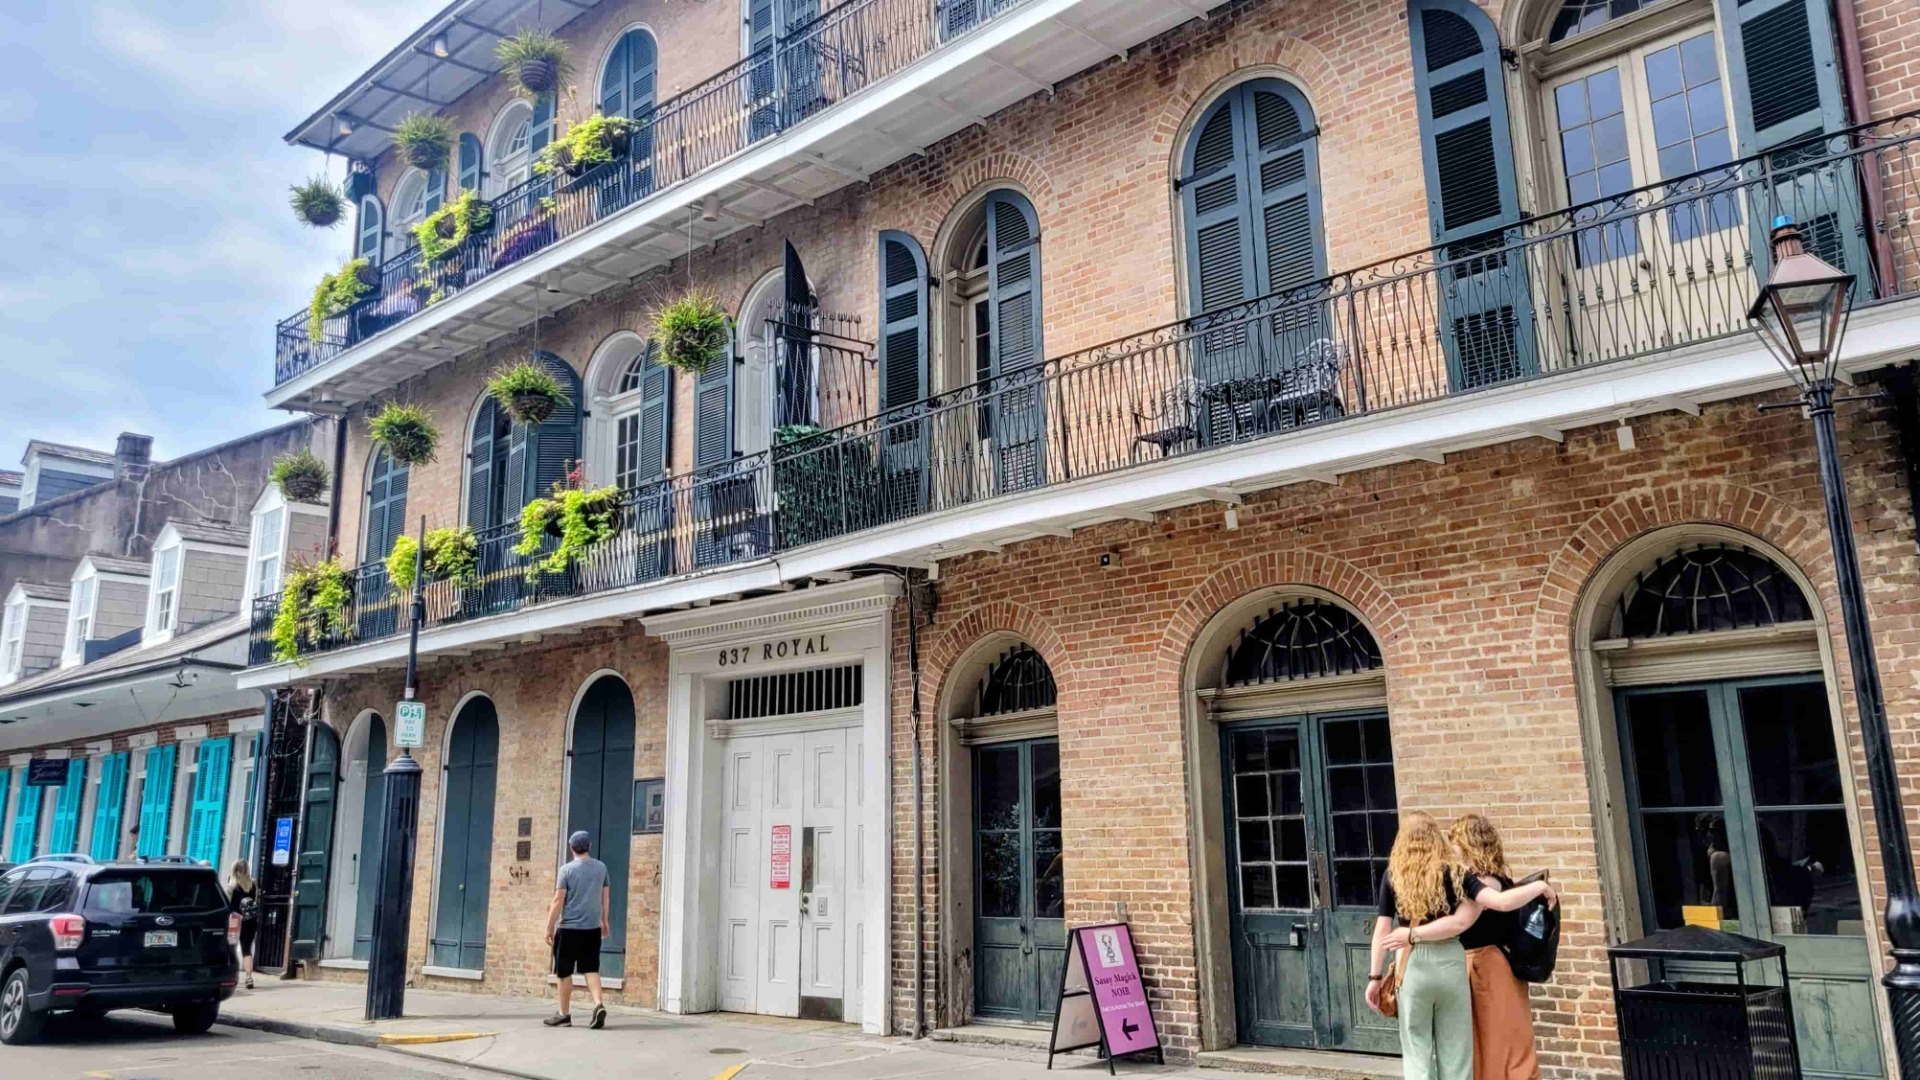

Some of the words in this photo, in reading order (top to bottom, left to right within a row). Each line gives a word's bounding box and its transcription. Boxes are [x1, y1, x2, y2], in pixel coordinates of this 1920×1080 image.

[718, 647, 750, 666] 837
[763, 635, 829, 660] ROYAL
[1094, 977, 1113, 986] Sassy
[1113, 972, 1137, 984] Magick
[1111, 986, 1131, 997] NOIR
